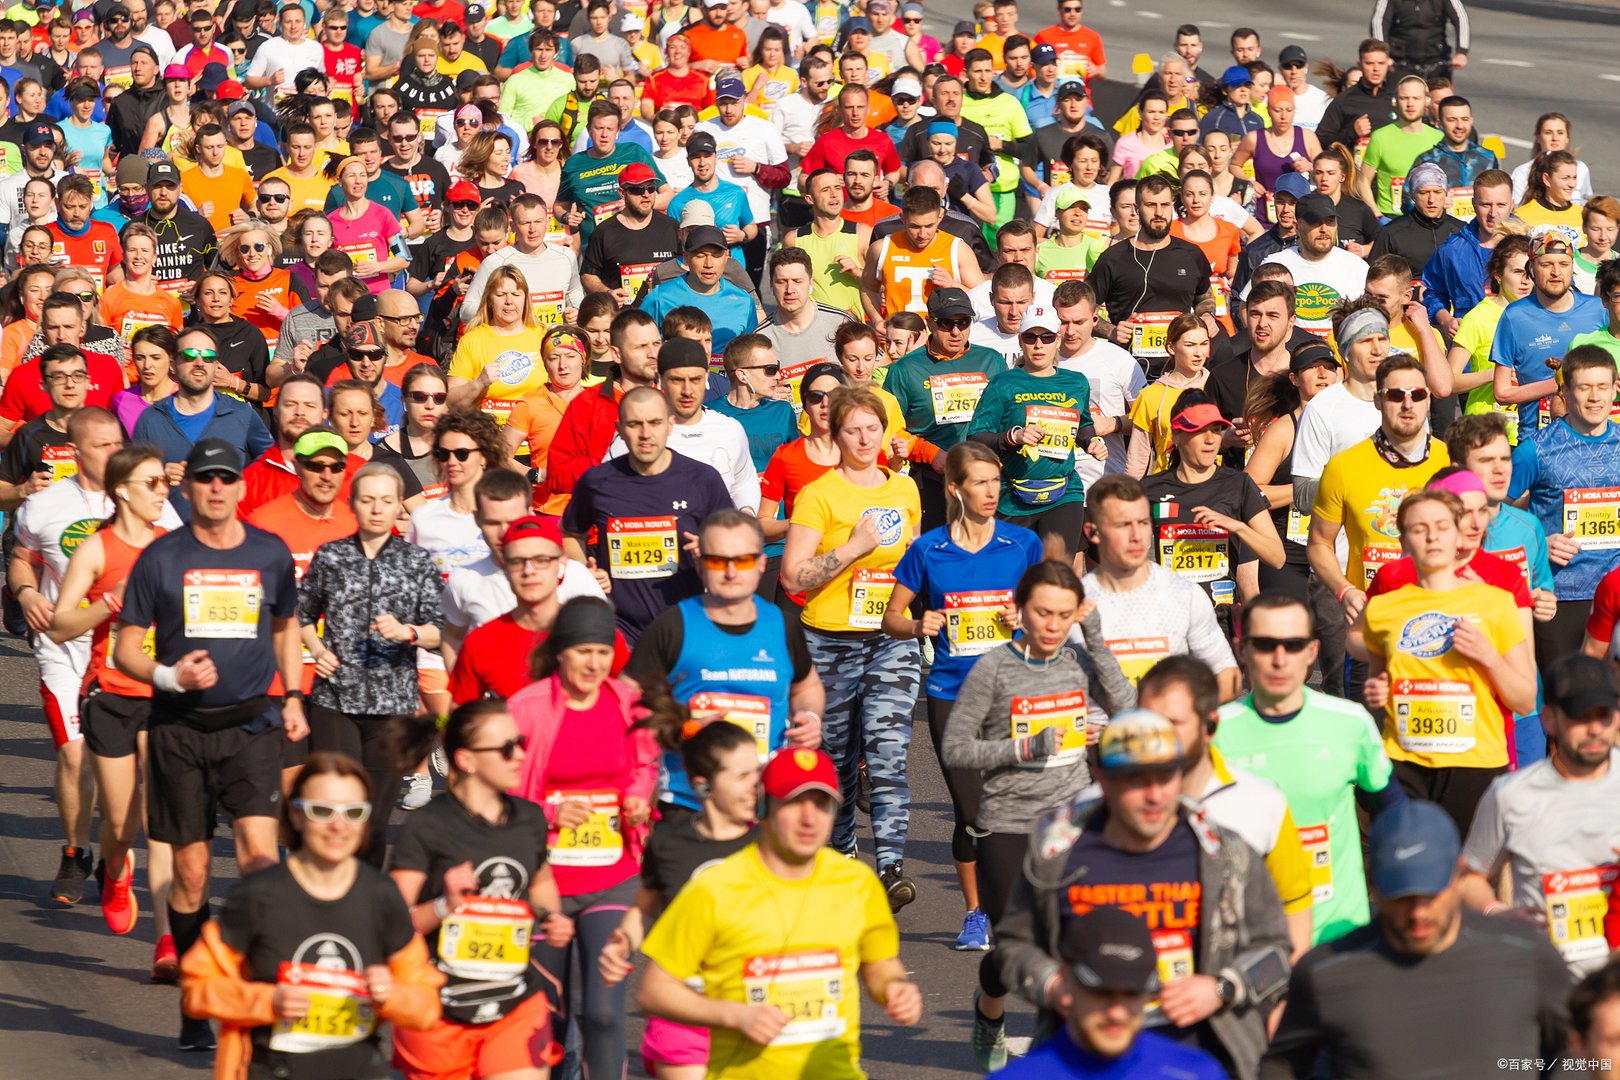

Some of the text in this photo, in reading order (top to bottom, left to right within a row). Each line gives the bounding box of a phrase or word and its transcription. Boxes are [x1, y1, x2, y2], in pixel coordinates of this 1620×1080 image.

[580, 164, 617, 179] saucony
[153, 255, 193, 268] AINING
[156, 269, 183, 280] CLUB
[1295, 297, 1338, 308] гро-Рос
[1015, 393, 1066, 404] saucony
[1058, 411, 1077, 419] ПОШТА
[1582, 490, 1620, 500] НОВА ПОШТ
[624, 520, 672, 529] НОВА ПОШТА
[1579, 521, 1615, 535] 1365
[624, 550, 662, 564] 4129
[1175, 555, 1214, 570] 2817
[984, 595, 1009, 603] ПОШТА
[209, 606, 239, 621] 635
[866, 601, 890, 614] 39
[965, 626, 996, 641] 588
[701, 668, 728, 681] Team
[1411, 717, 1457, 735] 3930
[567, 831, 601, 847] 346
[1068, 885, 1147, 905] FASTER
[468, 943, 505, 960] 924
[775, 999, 825, 1021] 347
